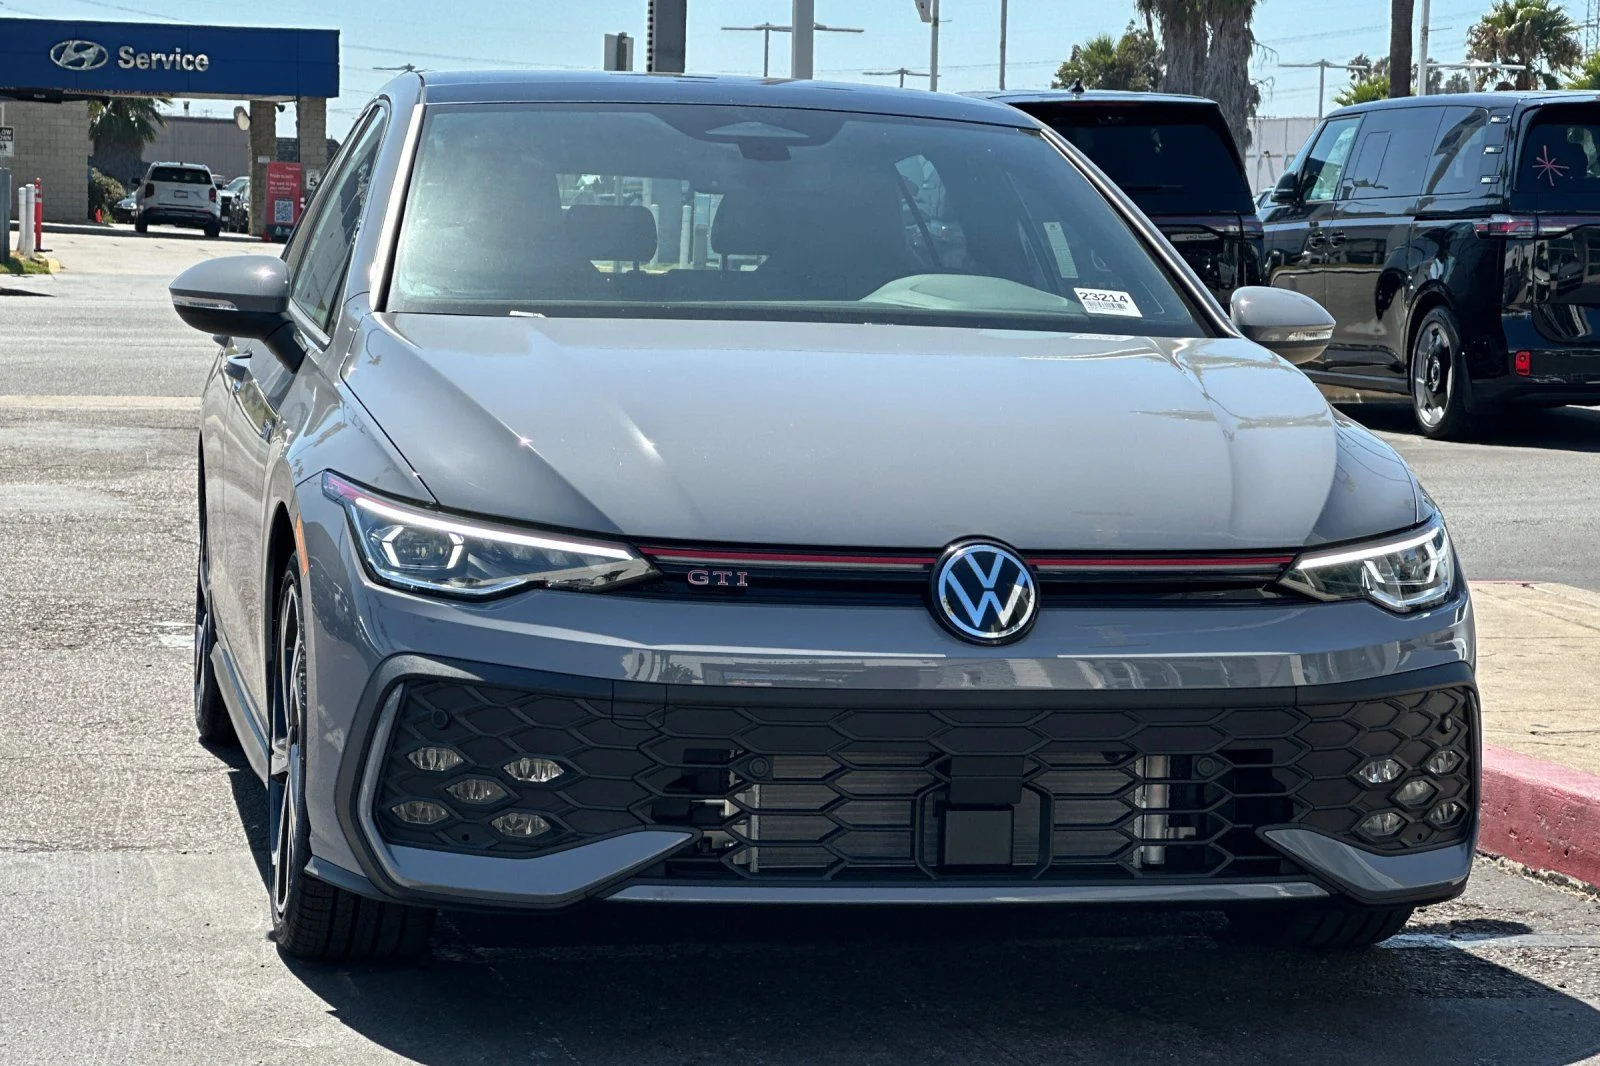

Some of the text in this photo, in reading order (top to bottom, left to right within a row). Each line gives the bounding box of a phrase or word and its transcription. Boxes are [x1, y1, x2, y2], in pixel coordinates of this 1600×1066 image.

[118, 46, 209, 71] Service
[309, 178, 317, 187] 5
[1079, 292, 1128, 304] 23214
[687, 569, 749, 587] GTI
